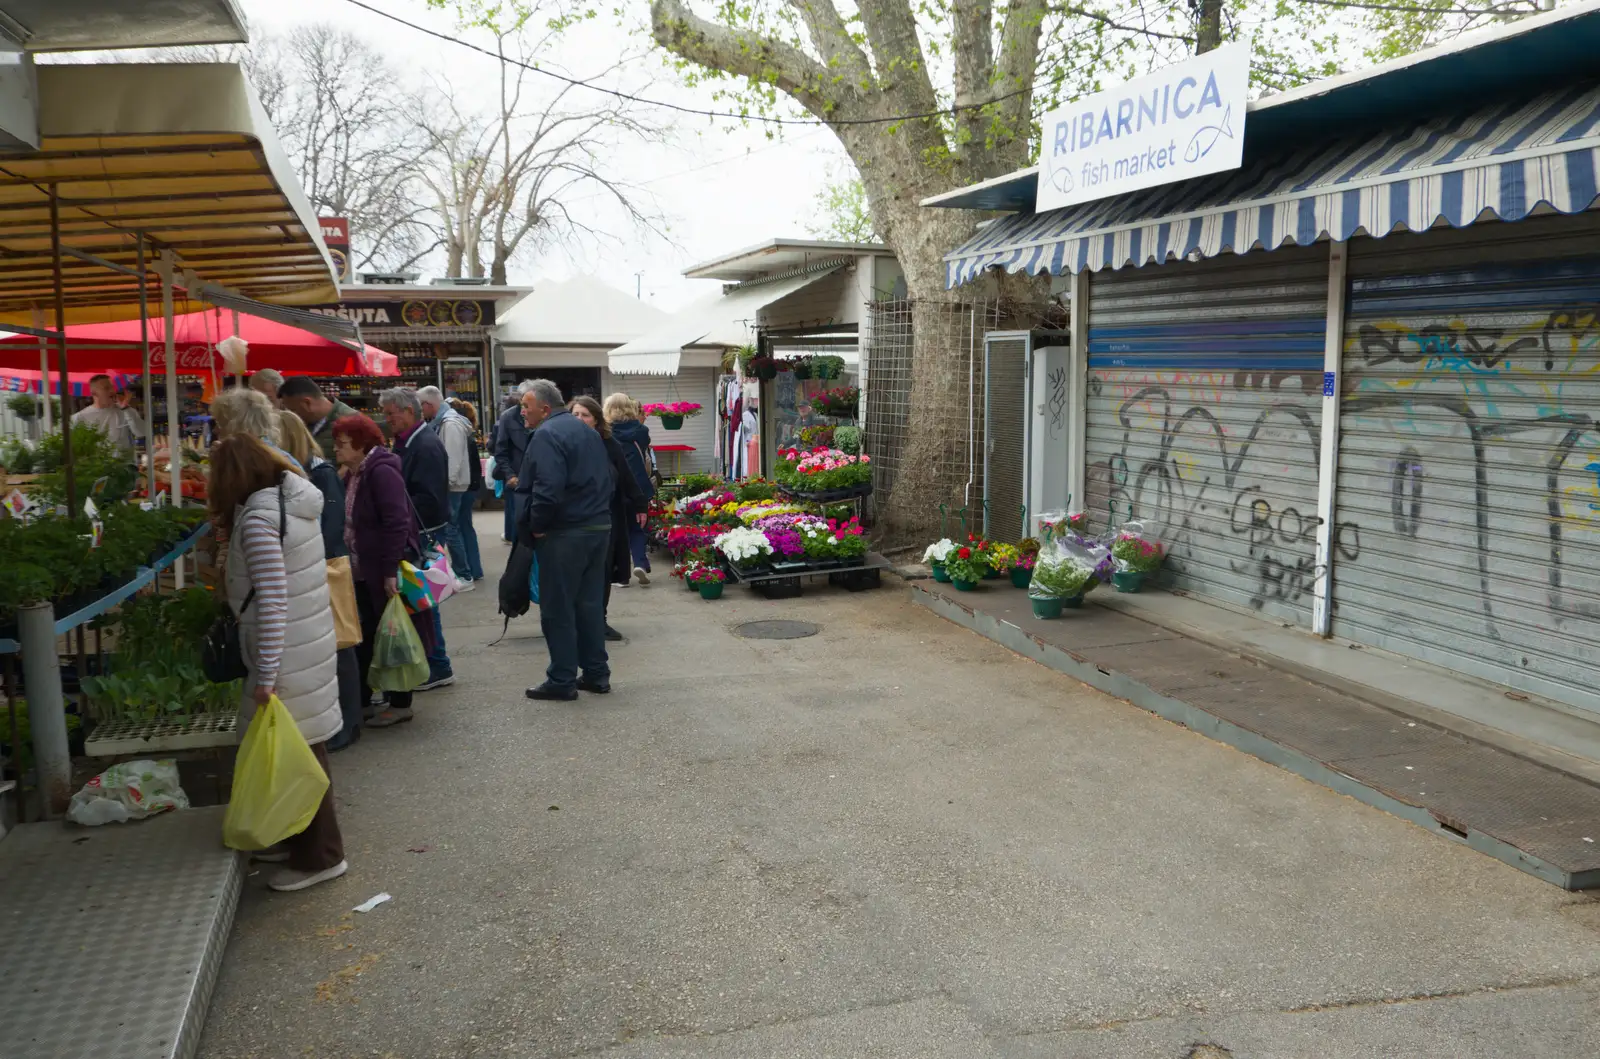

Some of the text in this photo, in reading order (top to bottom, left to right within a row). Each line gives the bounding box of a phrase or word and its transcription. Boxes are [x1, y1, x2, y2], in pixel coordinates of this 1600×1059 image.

[1053, 69, 1222, 157] RIBARNICA
[1080, 139, 1176, 188] fish market
